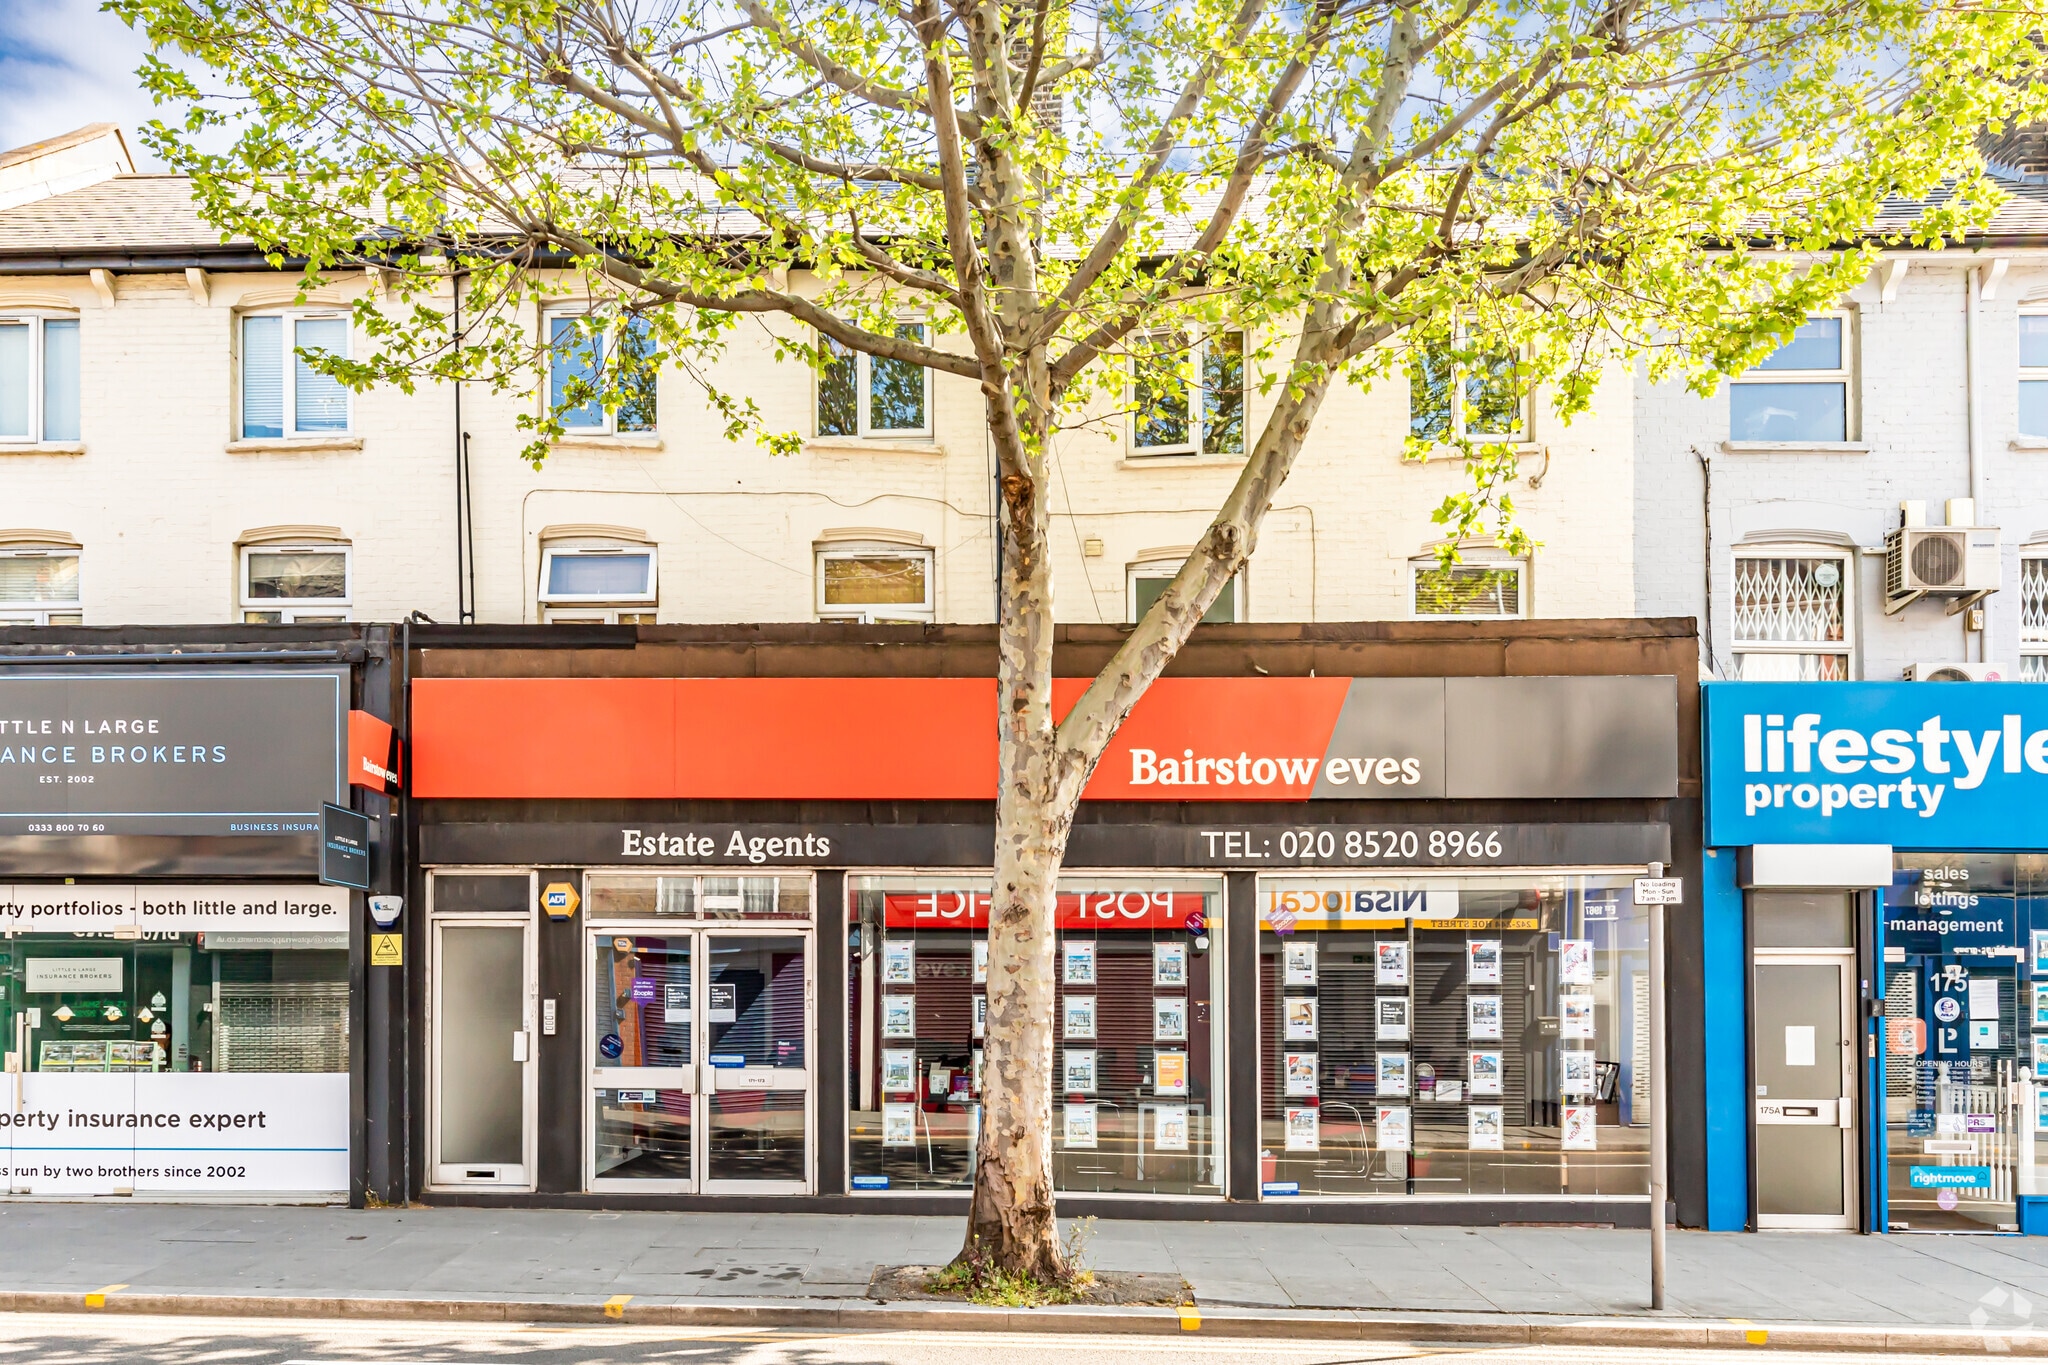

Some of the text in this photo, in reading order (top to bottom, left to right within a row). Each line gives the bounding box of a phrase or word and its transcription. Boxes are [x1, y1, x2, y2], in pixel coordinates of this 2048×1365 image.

[0, 720, 158, 734] TTLE N LARGE
[1, 746, 225, 763] ANCE BROKERS
[363, 757, 398, 784] Bairstow eves
[1129, 749, 1421, 785] Bairstow eves
[1745, 780, 1945, 817] property
[622, 830, 830, 863] Estate Agents
[1201, 831, 1502, 858] TEL: 020 8520 8966
[1923, 866, 1970, 880] sales
[549, 894, 566, 904] ADT
[1914, 891, 1979, 910] lettings
[0, 902, 24, 918] rty
[32, 901, 122, 918] portfolios
[144, 901, 185, 915] both
[194, 901, 235, 915] little
[243, 901, 276, 915] and
[285, 901, 336, 917] large.
[1890, 919, 2004, 935] management
[1930, 973, 1968, 992] 175
[1954, 1060, 1984, 1068] HOURS
[0, 1109, 266, 1131] perty insurance expert
[1967, 1118, 1986, 1126] PRS
[0, 1166, 245, 1178] s run by two brothers since 2002
[1914, 1173, 1976, 1185] rightmove
